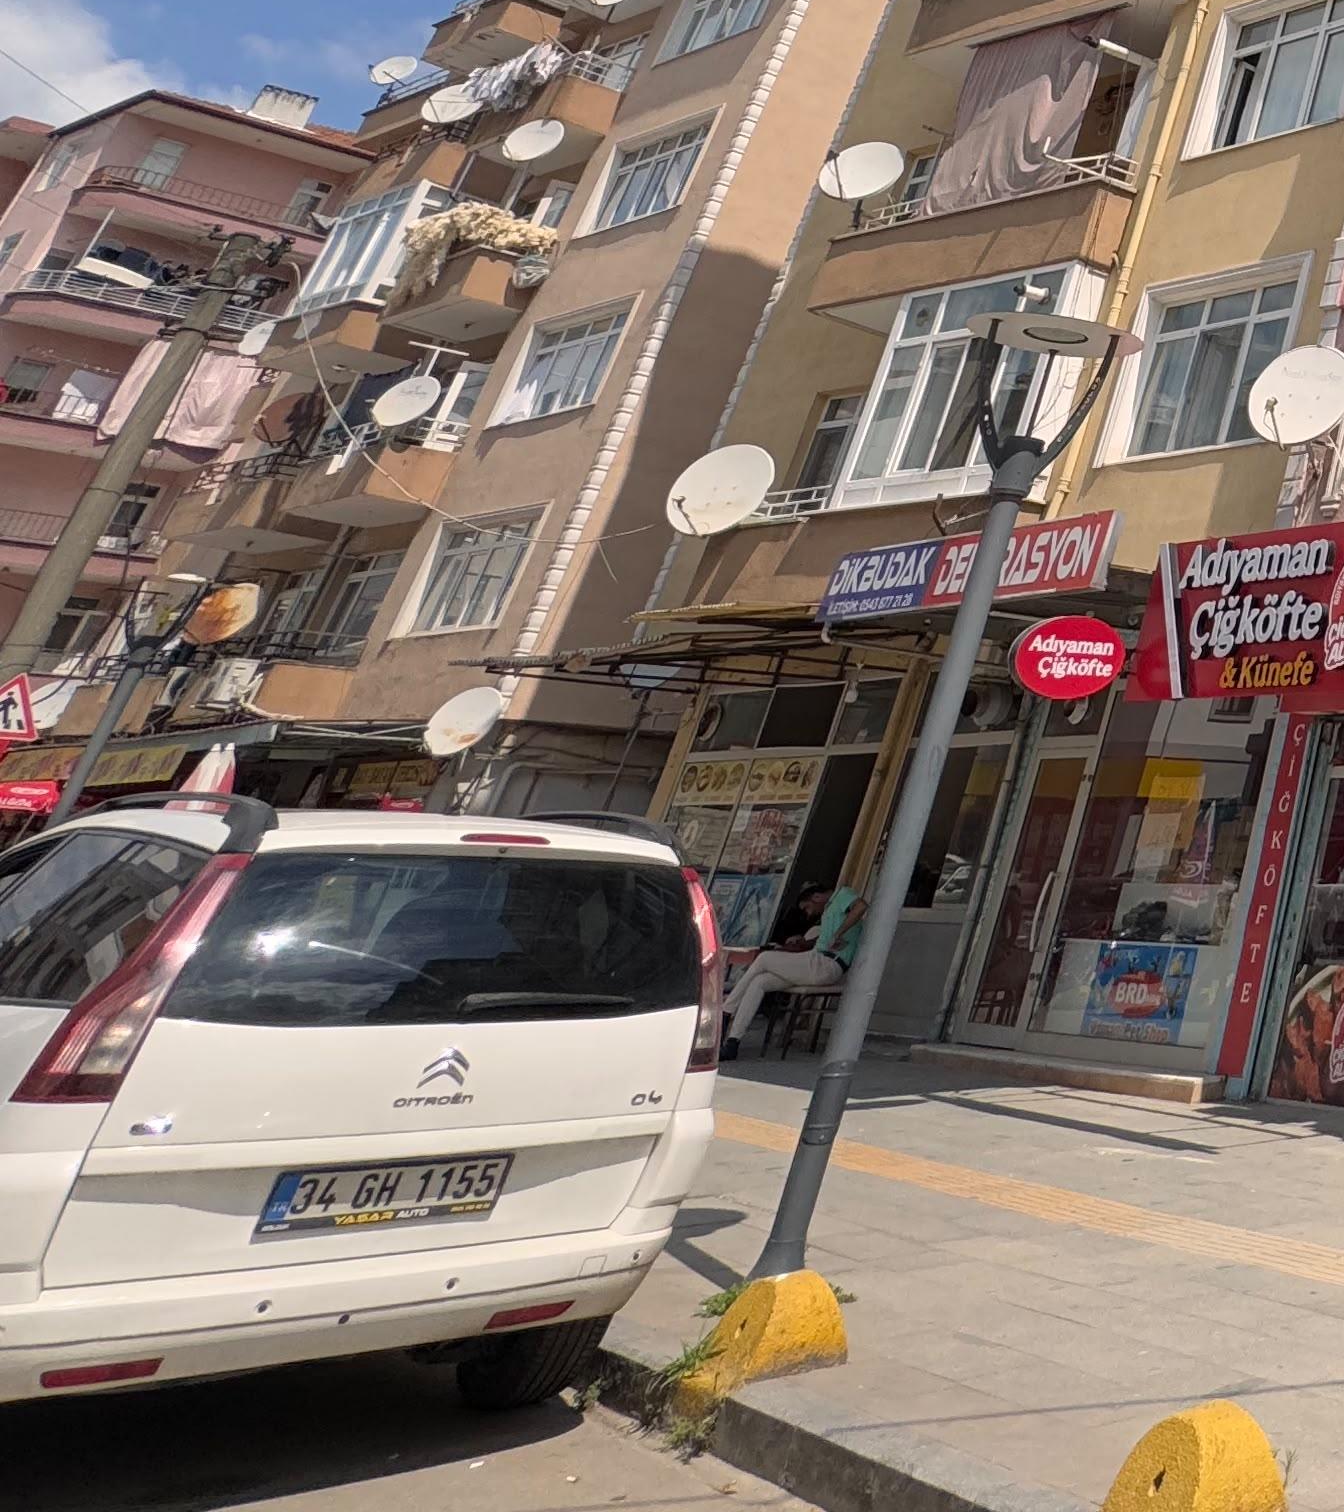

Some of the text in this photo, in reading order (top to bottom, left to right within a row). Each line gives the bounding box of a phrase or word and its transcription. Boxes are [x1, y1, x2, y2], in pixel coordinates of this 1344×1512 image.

[1178, 537, 1331, 597] Adıyaman
[1028, 634, 1115, 656] Adıyaman
[1189, 589, 1325, 662] Çiğköfte
[1037, 656, 1113, 680] Çiğköfte
[1219, 650, 1316, 690] & Künefe
[1238, 721, 1306, 1005] ÇİĞKÖFTE
[1115, 982, 1148, 1004] BRD
[291, 1178, 338, 1215] 34
[351, 1170, 404, 1210] GH
[415, 1162, 501, 1203] 1155
